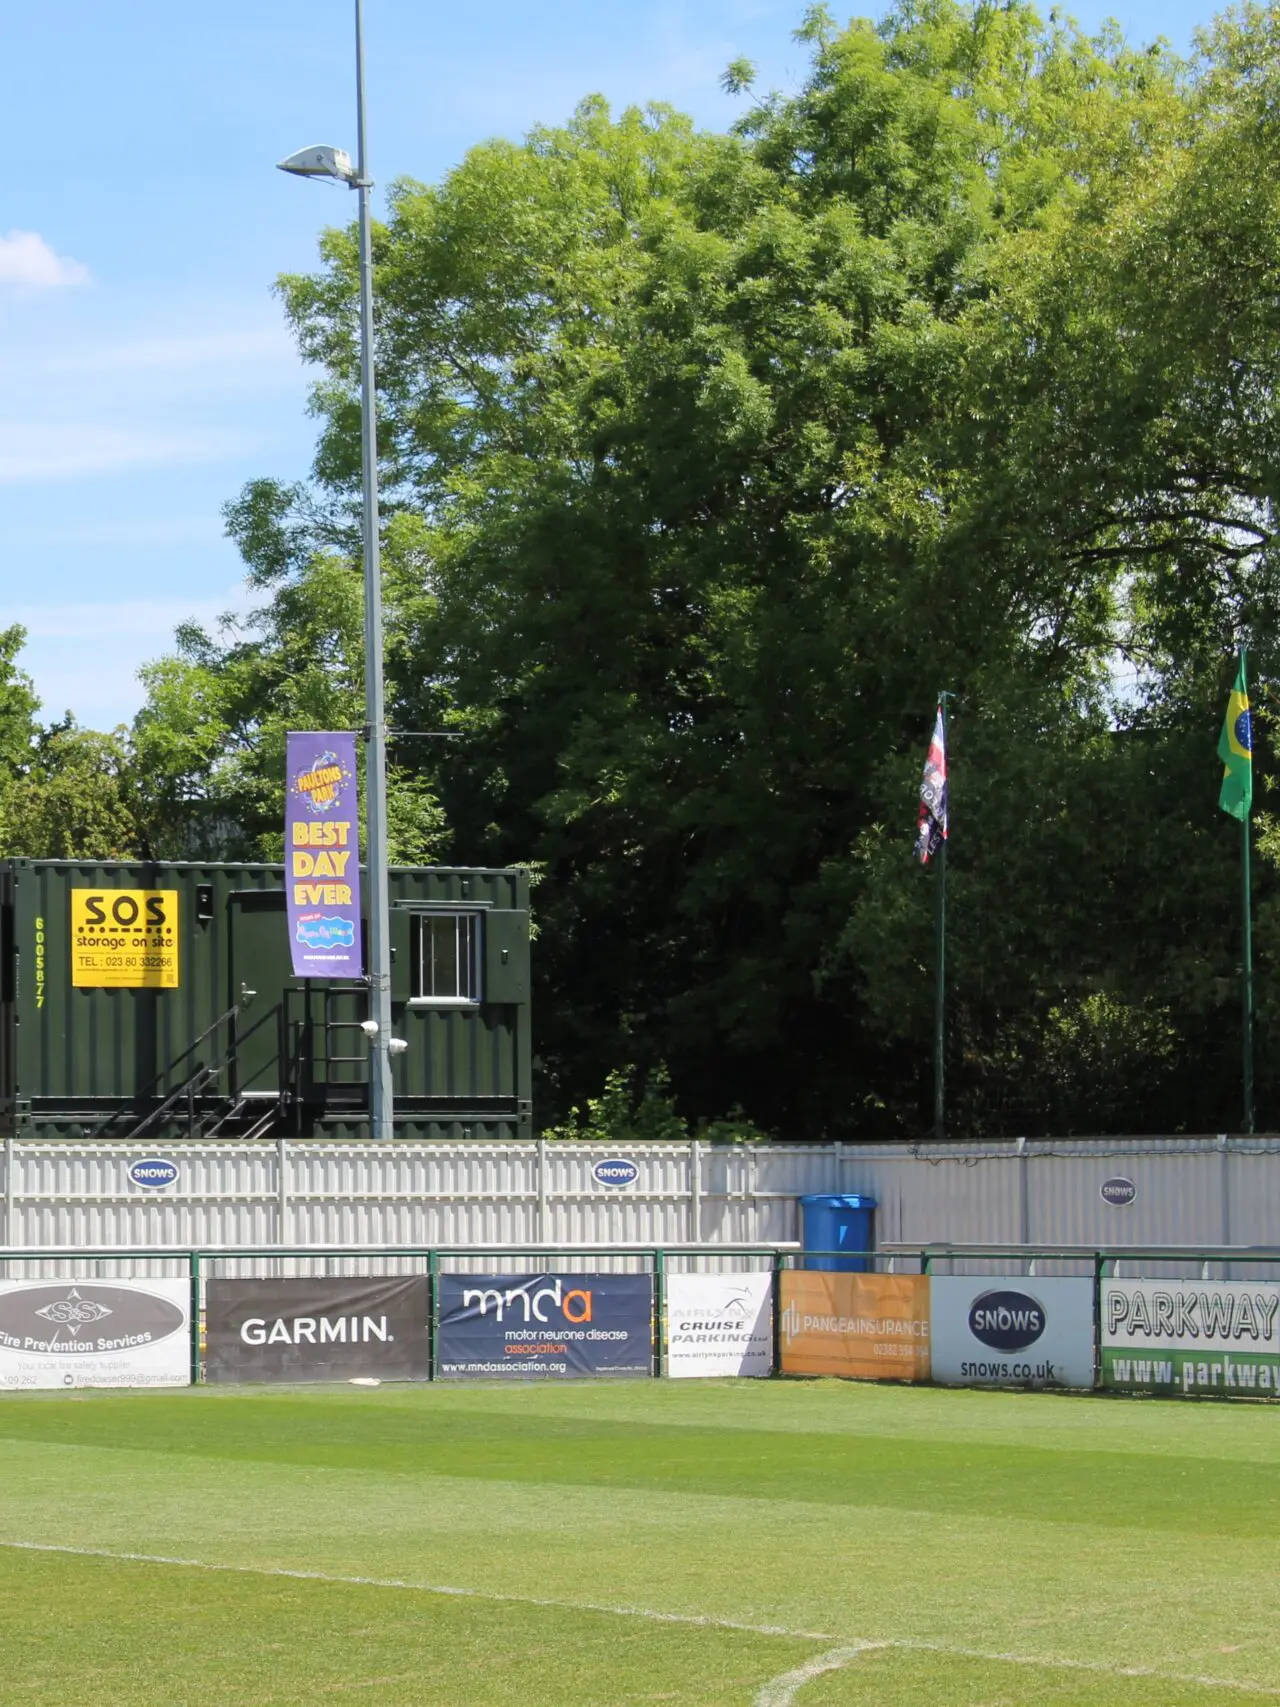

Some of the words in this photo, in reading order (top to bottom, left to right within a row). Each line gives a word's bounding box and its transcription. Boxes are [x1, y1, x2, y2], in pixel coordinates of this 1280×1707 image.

[292, 821, 351, 848] BEST
[292, 851, 351, 877] DAY
[294, 883, 352, 905] EVER
[85, 895, 167, 927] SOS
[76, 935, 126, 950] storage
[132, 939, 148, 948] on
[152, 935, 173, 948] site
[36, 917, 45, 1009] 6005877
[78, 957, 98, 967] TEL
[106, 957, 123, 967] 023
[125, 957, 137, 967] 80
[140, 957, 172, 968] 332266
[134, 1168, 174, 1178] SNOWS
[597, 1167, 635, 1177] SNOWS
[1103, 1187, 1134, 1197] SNOWS
[463, 1279, 593, 1323] mnda
[51, 1301, 98, 1322] S&S
[974, 1307, 1039, 1331] SNOWS
[1107, 1291, 1279, 1341] PARKWAY
[679, 1321, 745, 1331] CRUISE
[24, 1329, 94, 1353] Prevention
[97, 1330, 152, 1351] Services
[505, 1329, 537, 1341] motor
[539, 1330, 585, 1341] neurone
[586, 1329, 628, 1341] disease
[671, 1334, 754, 1343] PARKING
[504, 1343, 567, 1354] association
[17, 1361, 36, 1370] Your
[37, 1360, 59, 1369] local
[442, 1361, 567, 1373] www.mndassociation.org
[961, 1361, 1055, 1379] snows.co.uk
